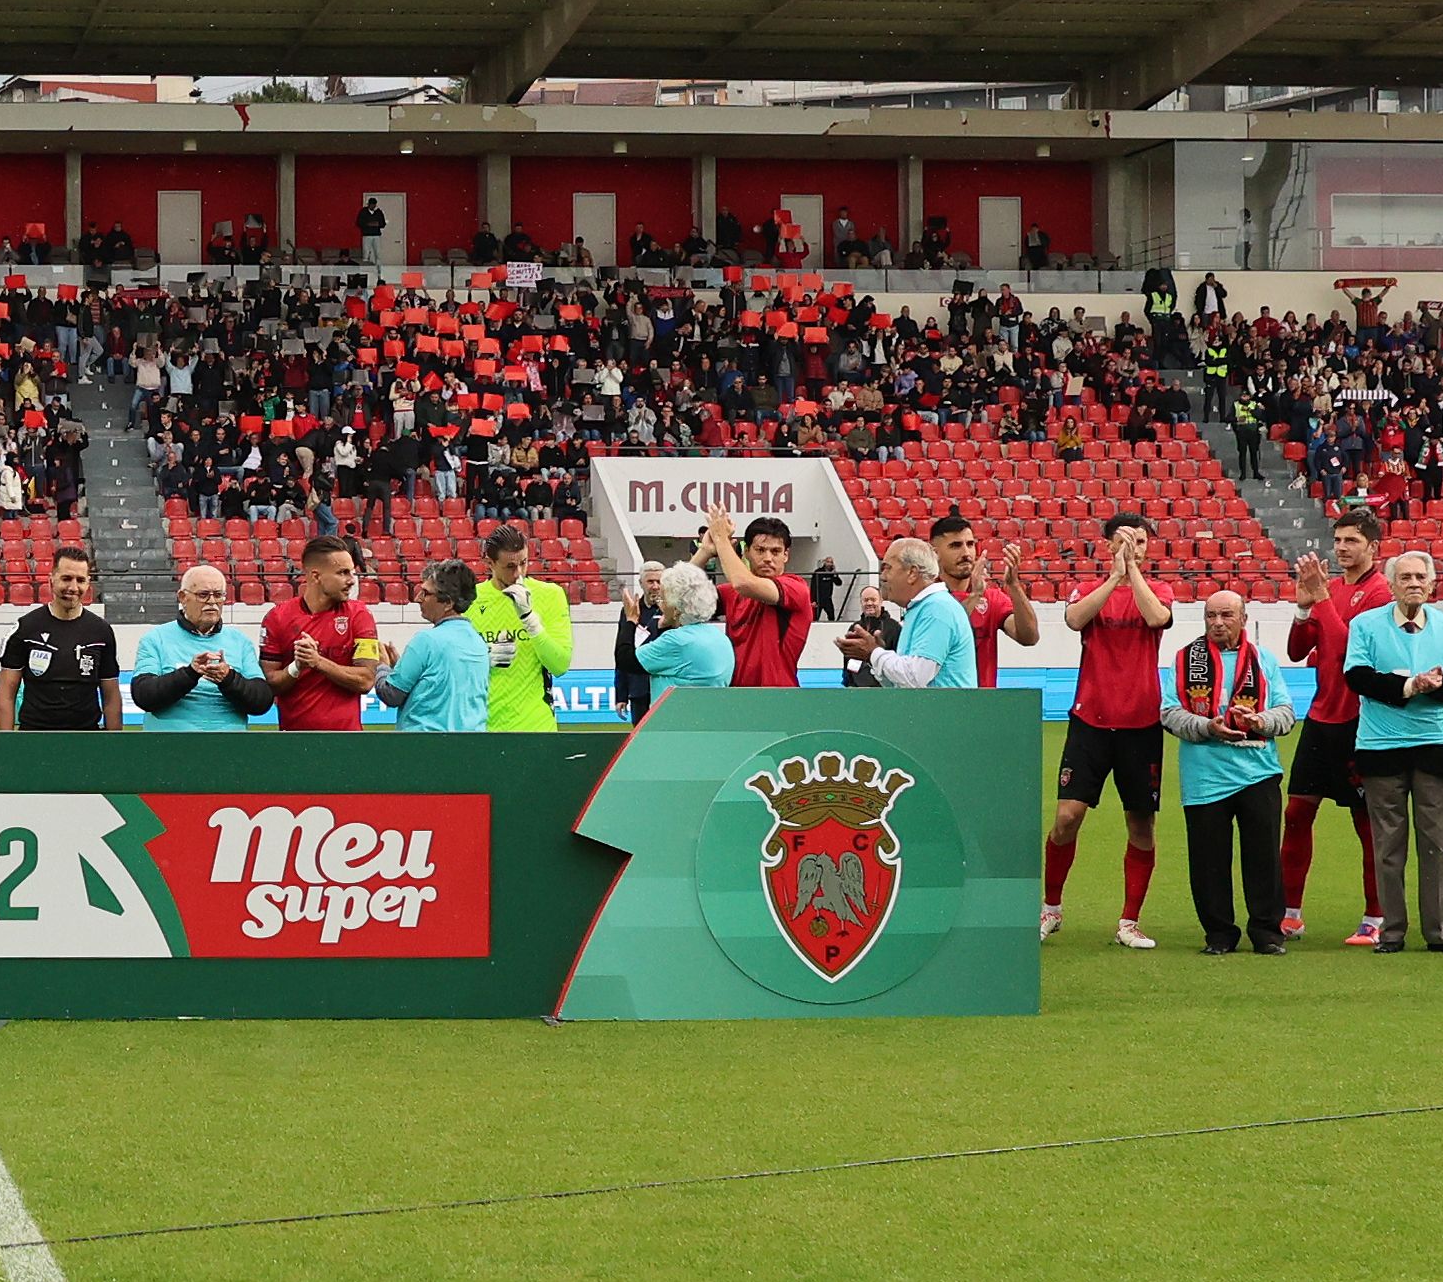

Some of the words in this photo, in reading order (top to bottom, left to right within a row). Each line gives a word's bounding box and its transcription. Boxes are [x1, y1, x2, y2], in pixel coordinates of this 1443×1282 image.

[32, 649, 49, 660] FIFA
[792, 835, 806, 852] F
[852, 833, 869, 851] C
[241, 883, 437, 944] super
[825, 945, 840, 963] P
